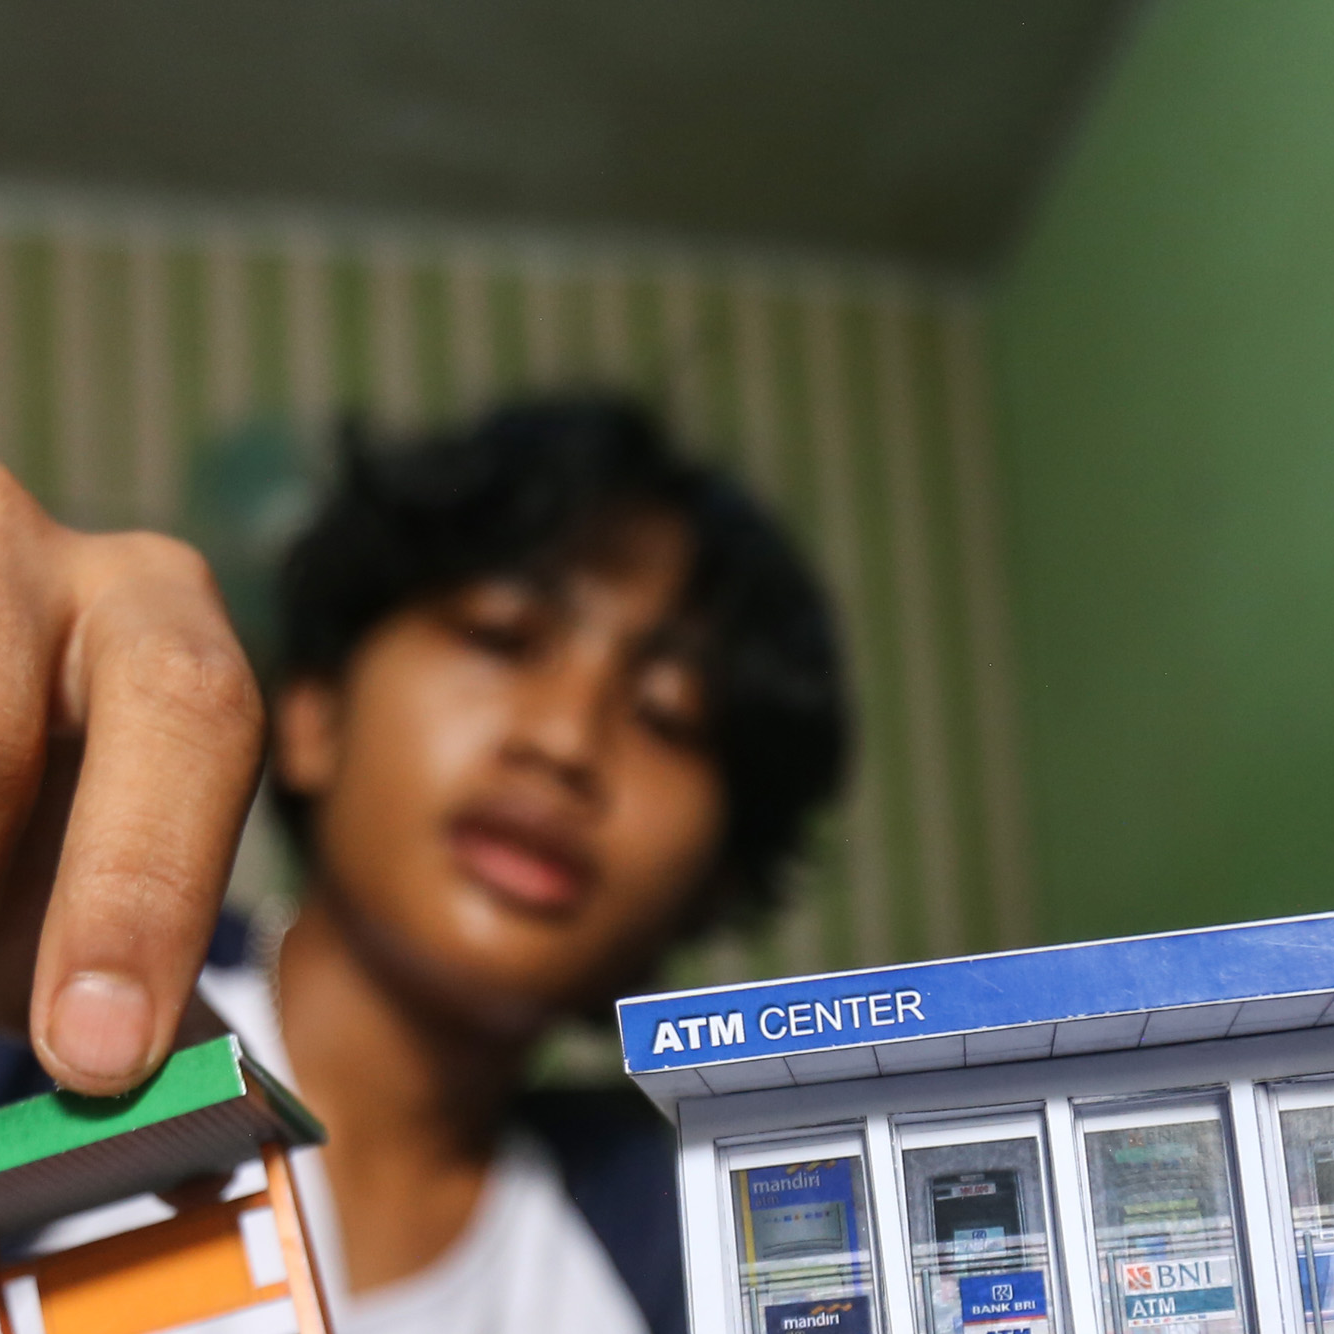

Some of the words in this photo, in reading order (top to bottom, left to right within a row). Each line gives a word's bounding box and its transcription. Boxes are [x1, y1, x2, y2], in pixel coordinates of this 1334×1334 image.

[652, 1012, 746, 1054] ATM
[759, 990, 926, 1040] CENTER
[753, 1171, 820, 1194] mandiri
[1157, 1261, 1212, 1289] BNI
[972, 1302, 1011, 1315] BANK
[1014, 1300, 1036, 1312] BRI
[1132, 1297, 1176, 1318] ATM
[783, 1312, 840, 1331] mandiri
